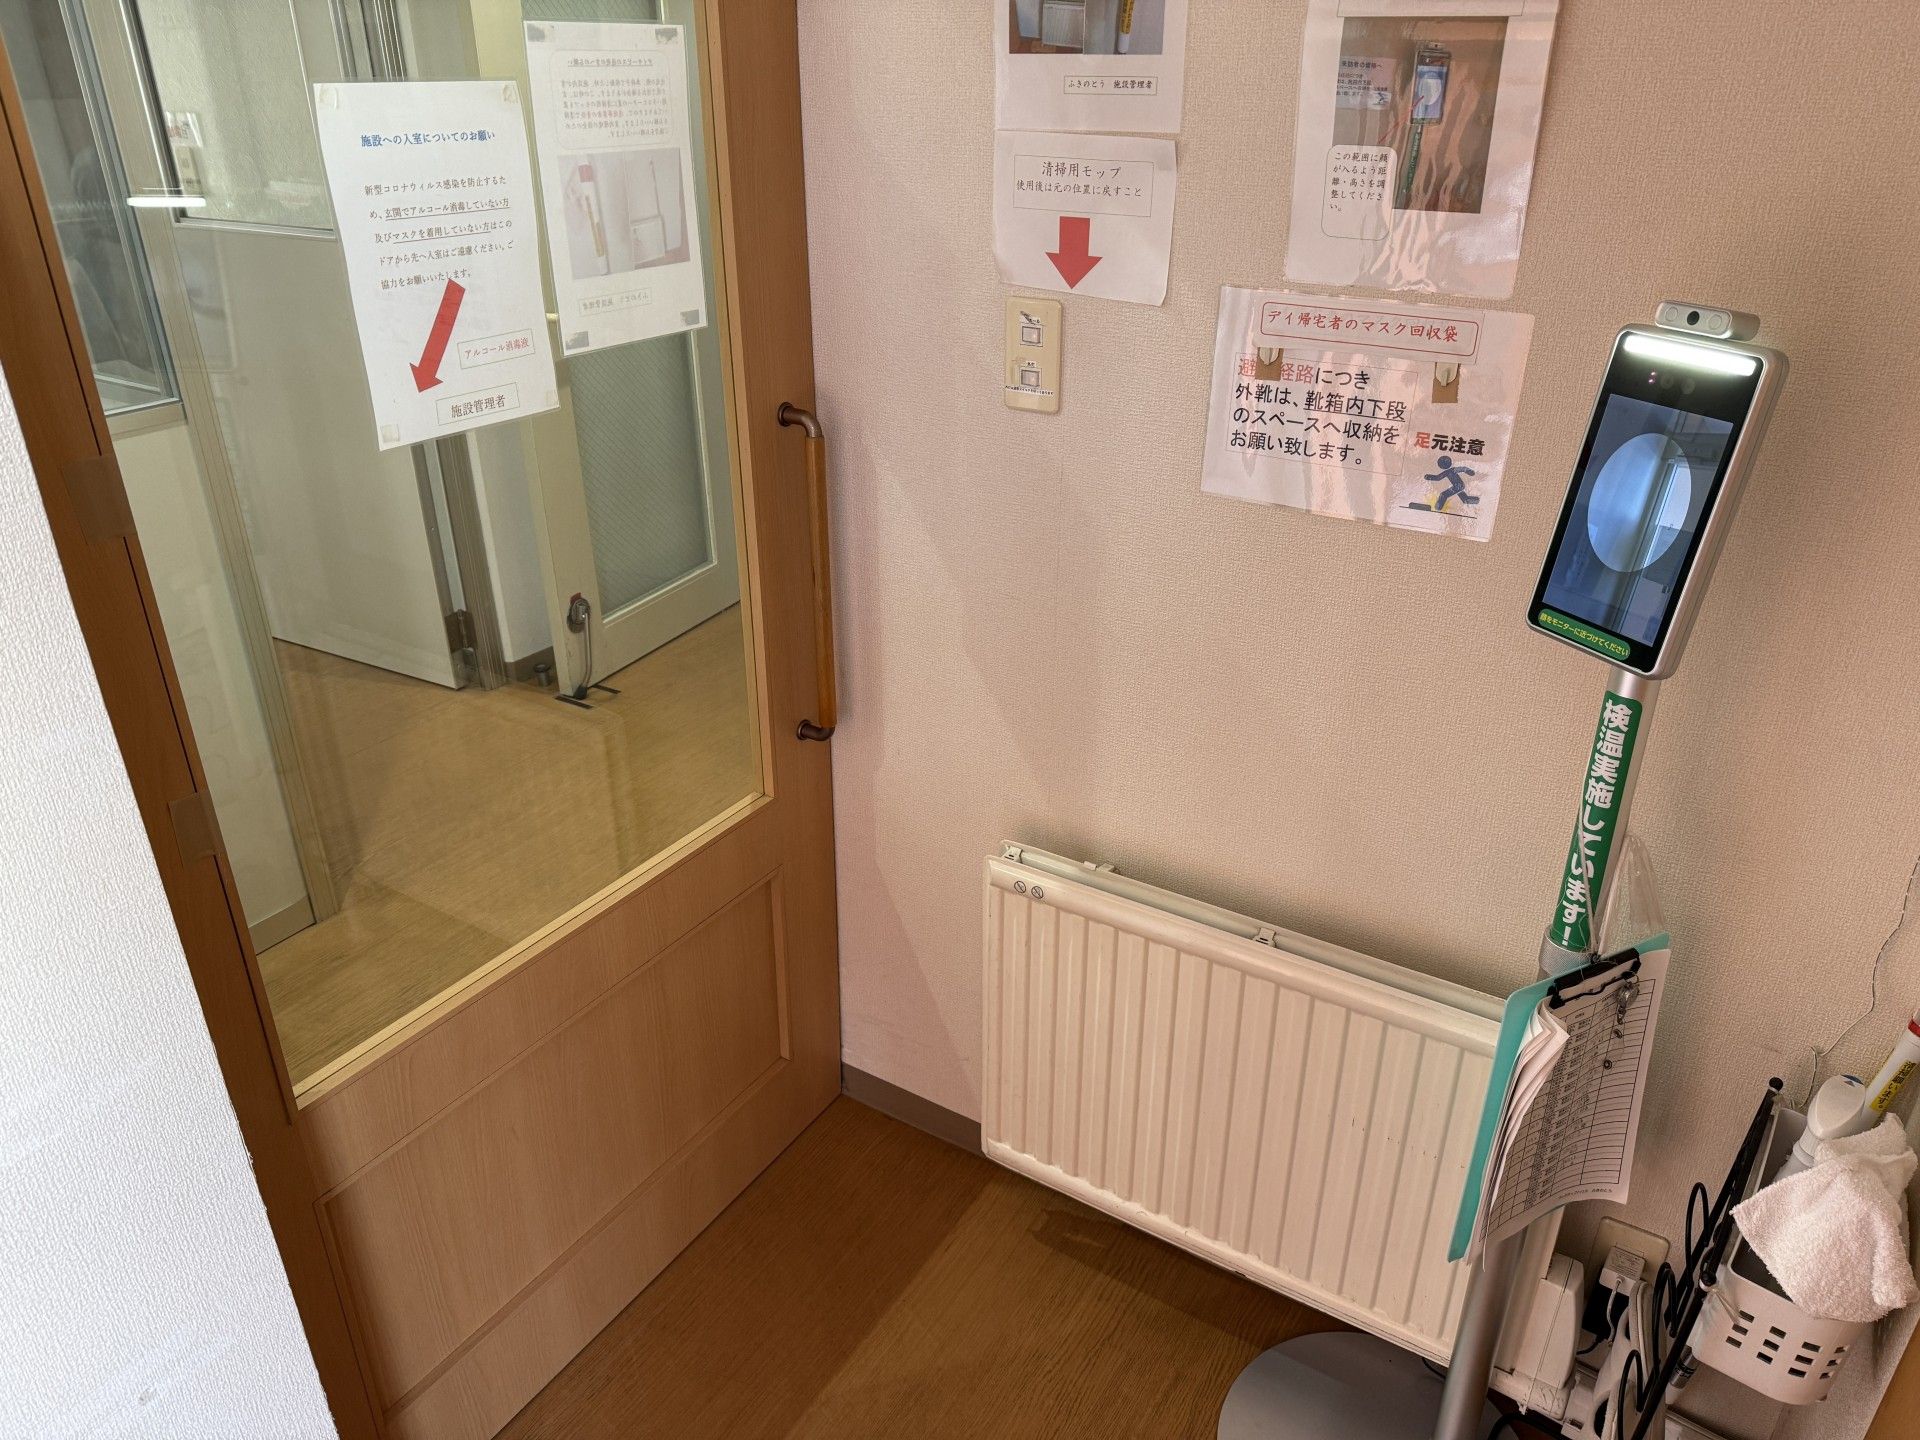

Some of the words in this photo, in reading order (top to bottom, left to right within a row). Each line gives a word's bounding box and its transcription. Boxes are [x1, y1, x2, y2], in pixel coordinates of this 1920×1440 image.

[1068, 80, 1105, 88] ふきのとう
[1113, 79, 1153, 90] 施設管理者
[361, 129, 496, 147] 施設への入室についてのお願い
[1335, 152, 1388, 164] この範囲に顔
[1041, 160, 1122, 180] 清掃用モップ
[1332, 165, 1387, 176] が入るよう距
[364, 175, 507, 196] 新型コロナウィルス感染を防止するた
[1016, 179, 1142, 198] 使用後は元の位置に戻すこと
[1331, 177, 1385, 189] 離・高さを調
[1330, 189, 1384, 201] 整してくださ
[369, 198, 510, 220] め、玄関でアルコール消毒していない方
[1330, 203, 1342, 212] い。
[375, 219, 513, 244] 及びマスクを着用していない方はこの
[381, 268, 472, 290] 協力をお願いいたします。
[1268, 310, 1458, 342] デイ帰宅者のマスク回収袋
[464, 338, 530, 359] アルコール消毒液
[1238, 358, 1370, 389] 避経路につき
[451, 394, 506, 418] 施設管理者
[1235, 384, 1407, 420] 外靴は、靴箱内下段
[1233, 408, 1400, 445] のスペースへ収納を
[1230, 429, 1363, 464] お願い致します。
[1413, 431, 1486, 456] 足元注意
